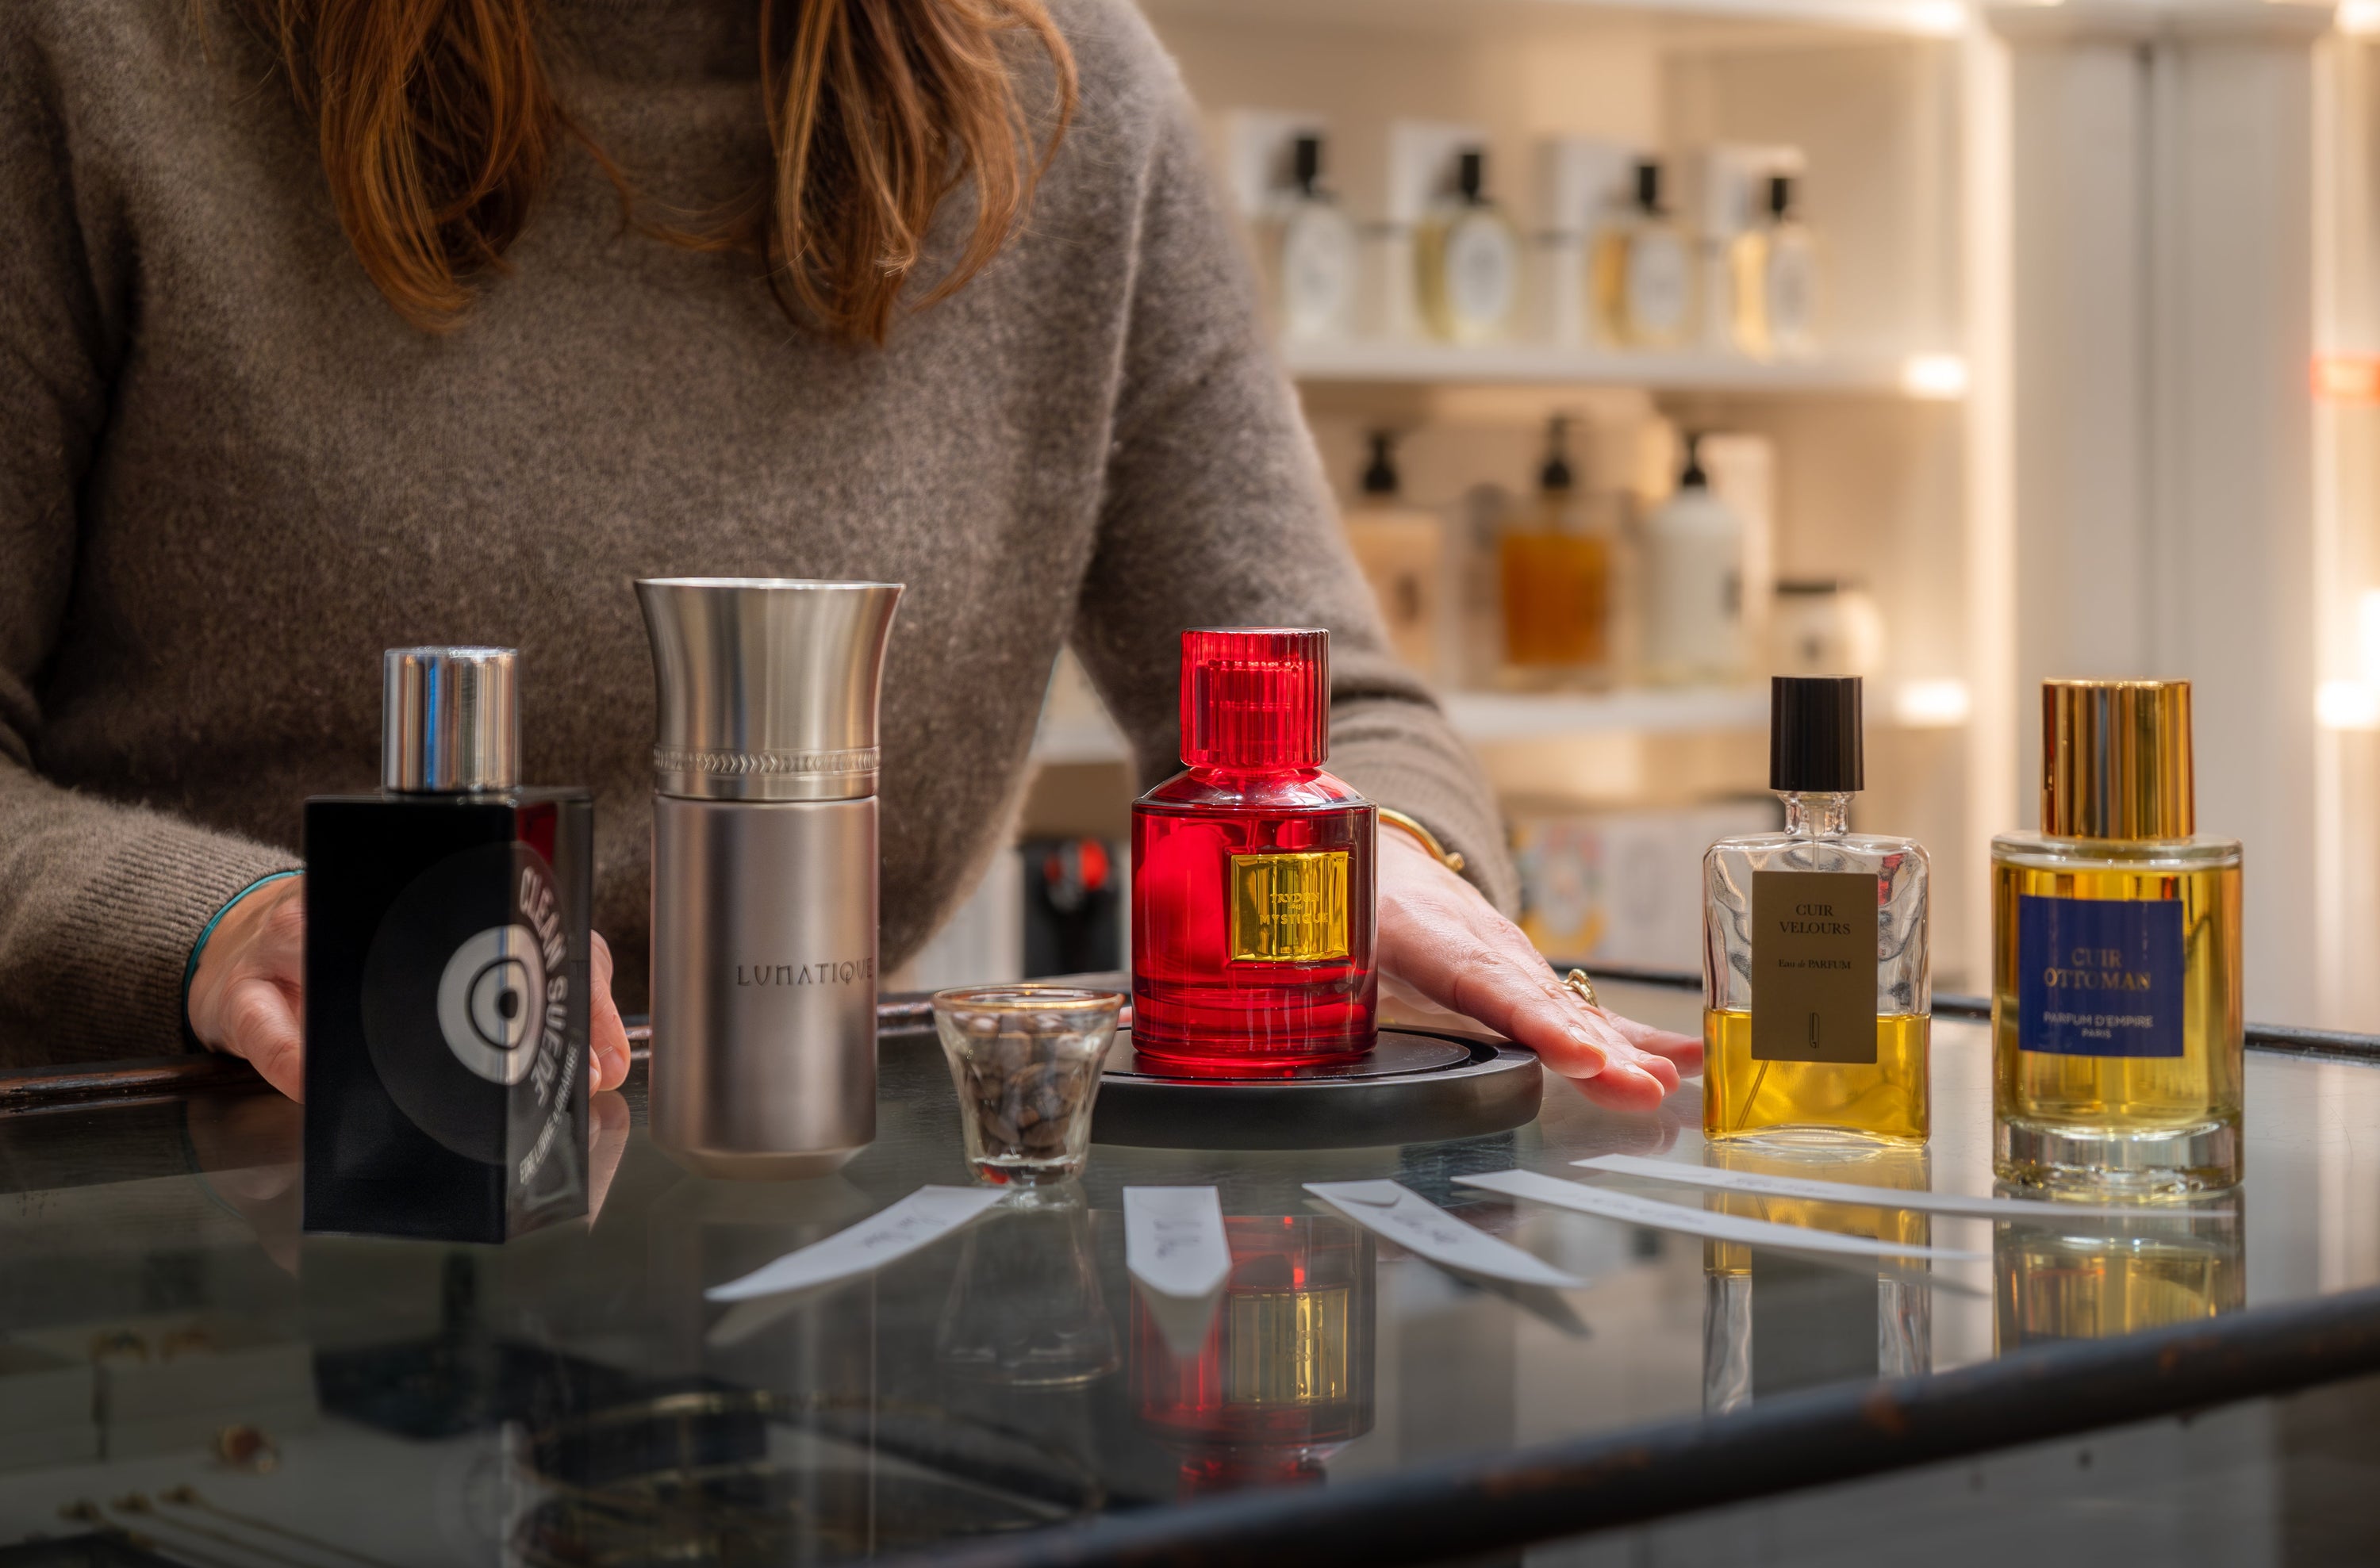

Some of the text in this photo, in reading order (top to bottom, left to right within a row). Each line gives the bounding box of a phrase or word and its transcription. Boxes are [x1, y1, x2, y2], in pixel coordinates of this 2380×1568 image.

[1795, 903, 1834, 917] CUIR
[1259, 913, 1329, 926] MYSTIQUE
[1779, 921, 1852, 934] VELOURS
[1778, 958, 1852, 969] Eau de PARFUM
[2071, 947, 2122, 968] CUIR
[736, 957, 873, 987] LUNATIQUE
[2044, 967, 2152, 991] OTTOMAN
[2043, 1010, 2154, 1029] PARFUM D'EMPIRE
[532, 975, 569, 1107] SUEDE
[2081, 1028, 2112, 1040] PARIS
